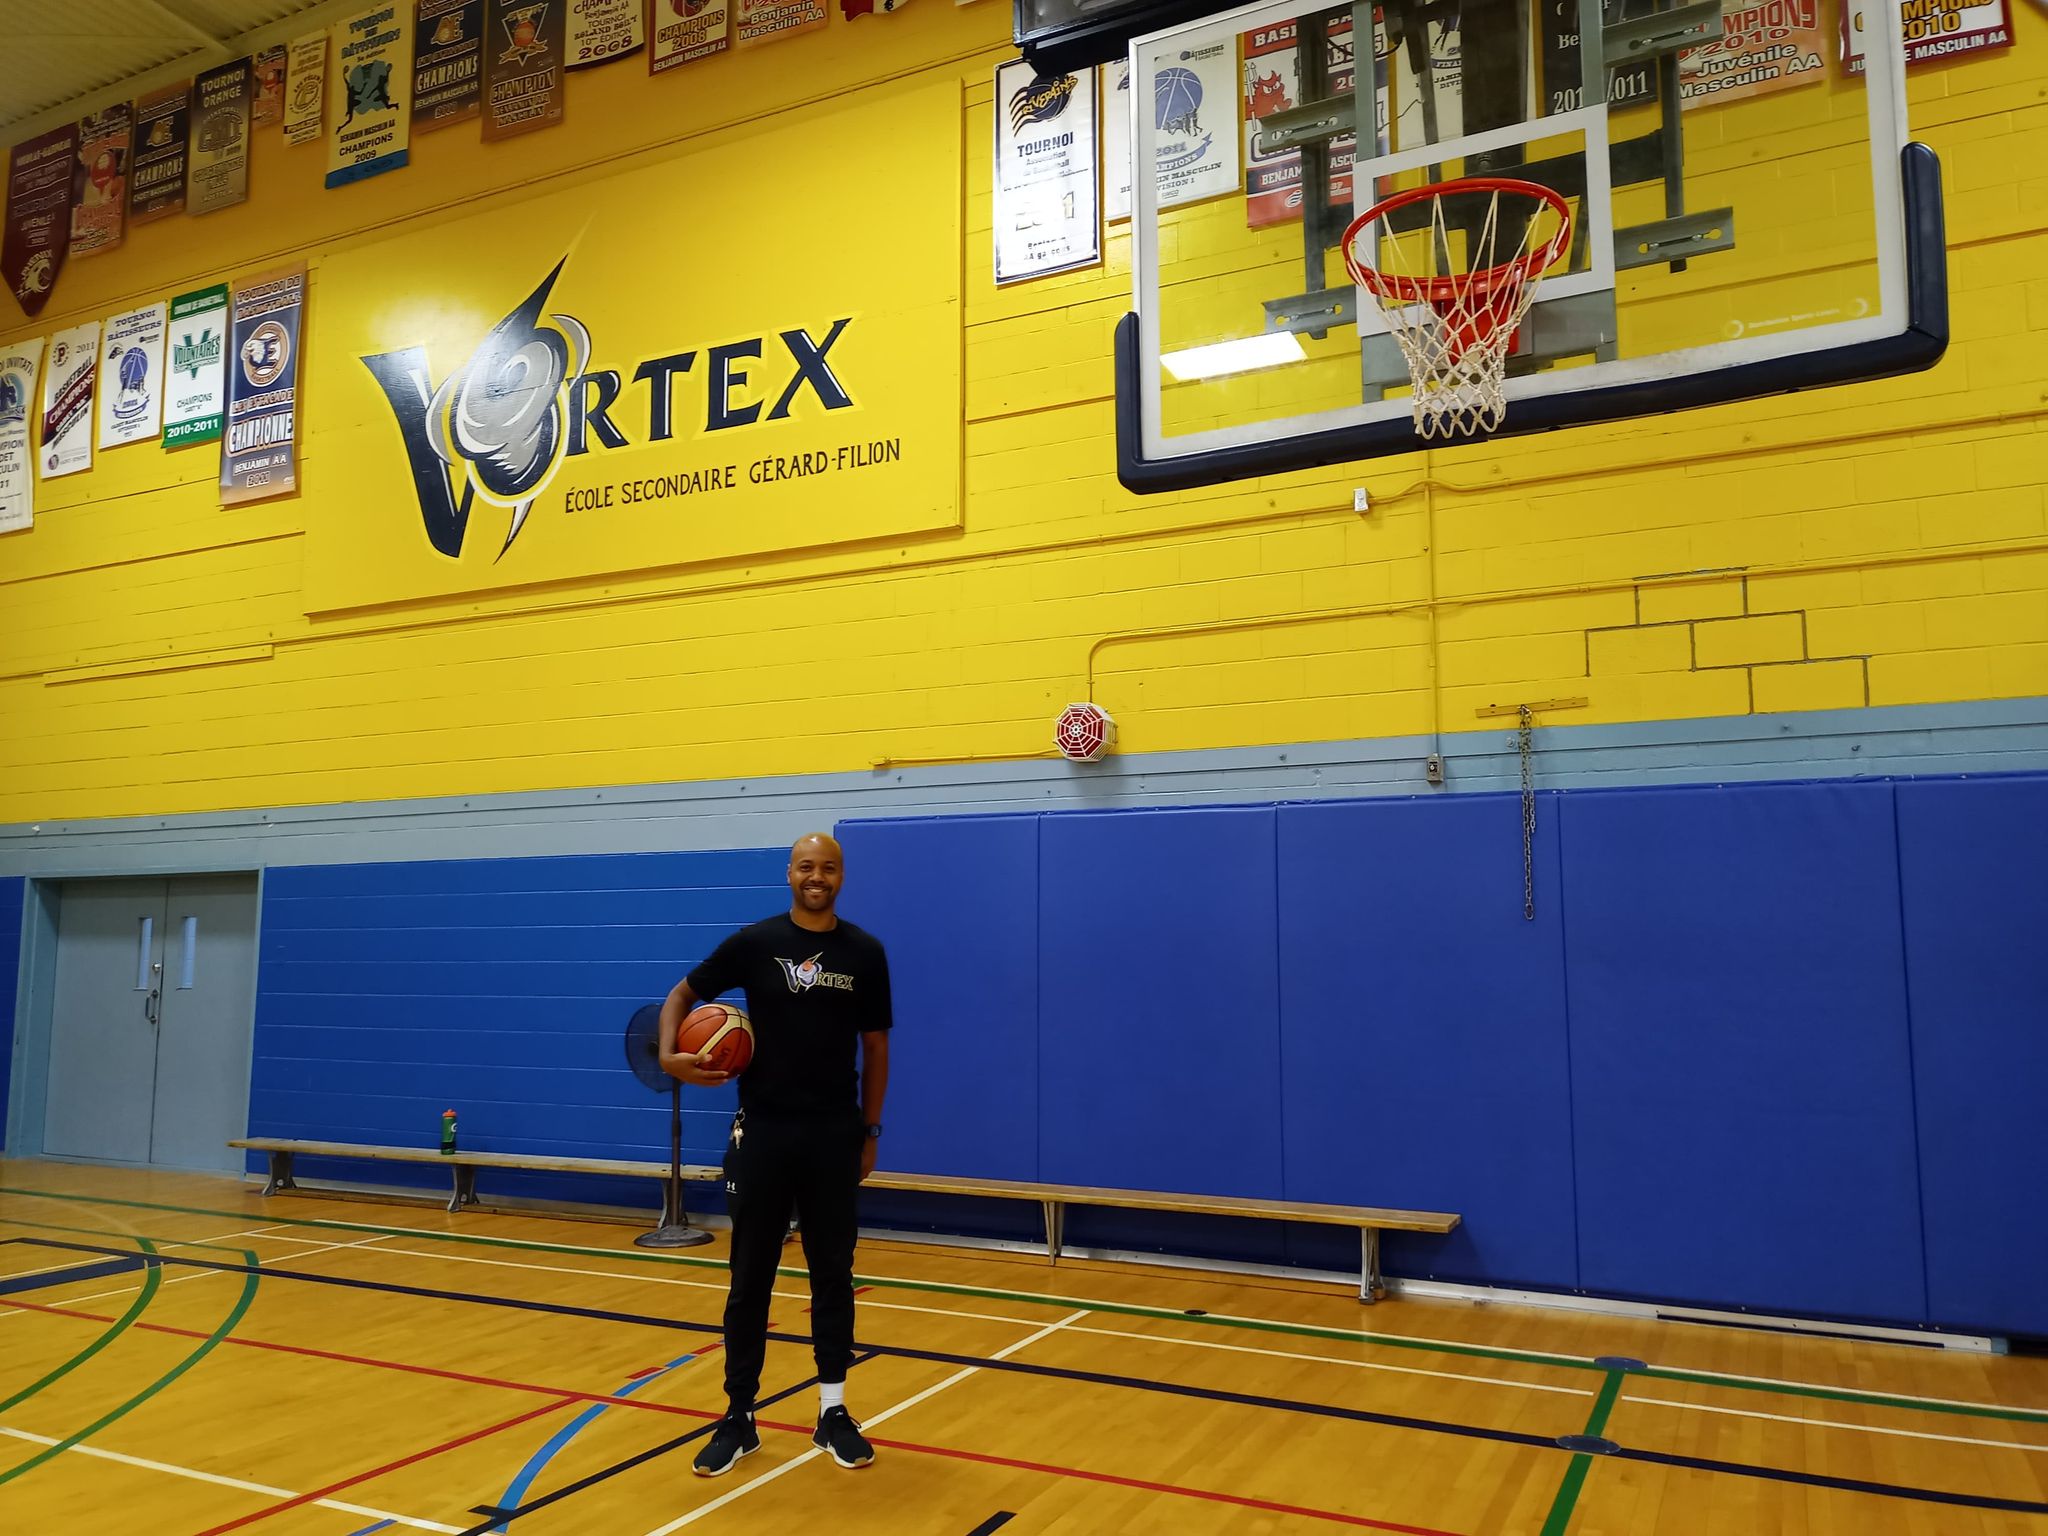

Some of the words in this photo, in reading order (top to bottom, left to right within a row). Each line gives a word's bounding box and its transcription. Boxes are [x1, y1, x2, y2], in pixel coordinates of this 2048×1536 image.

[588, 14, 626, 28] TOURNOI
[657, 9, 726, 44] CHAMPIONS
[739, 16, 801, 41] Masculin
[804, 8, 825, 24] AA
[750, 0, 815, 25] Benjamin
[672, 30, 708, 52] 2008
[1700, 28, 1791, 58] 2010
[1915, 34, 1985, 59] MASCULIN
[1988, 30, 2008, 46] AA
[653, 56, 684, 72] BENJAMIN
[684, 44, 716, 62] MASCULIN
[716, 40, 727, 51] AA
[1696, 44, 1797, 78] Juvénile
[201, 69, 246, 94] TOURNOI
[417, 55, 478, 91] CHAMPIONS
[1680, 66, 1780, 99] Masculin
[1785, 53, 1824, 76] AA
[203, 85, 242, 108] ORANGE
[339, 132, 393, 157] CHAMPIONS
[354, 150, 376, 164] 2009
[1017, 132, 1075, 158] TOURNOI
[135, 157, 184, 188] CHAMPIONS
[1171, 161, 1223, 180] MASCULIN
[115, 309, 157, 328] TOURNOI
[75, 341, 96, 355] 2011
[174, 334, 220, 367] VOLONTAIRES
[54, 356, 93, 404] BASKETBALL
[49, 370, 96, 424] CHAMPIONS
[176, 392, 213, 409] CHAMPIONS
[360, 254, 854, 564] VORTEX
[167, 418, 219, 438] 2010-2011
[229, 412, 294, 453] CHAMPIONNE
[234, 458, 270, 477] BENJAMIN
[273, 453, 288, 466] AA
[564, 485, 615, 514] ÉCOLE
[621, 465, 737, 504] SECONDAIRE
[749, 438, 901, 485] GÉRARD-FILION
[774, 951, 854, 993] VORTEX
